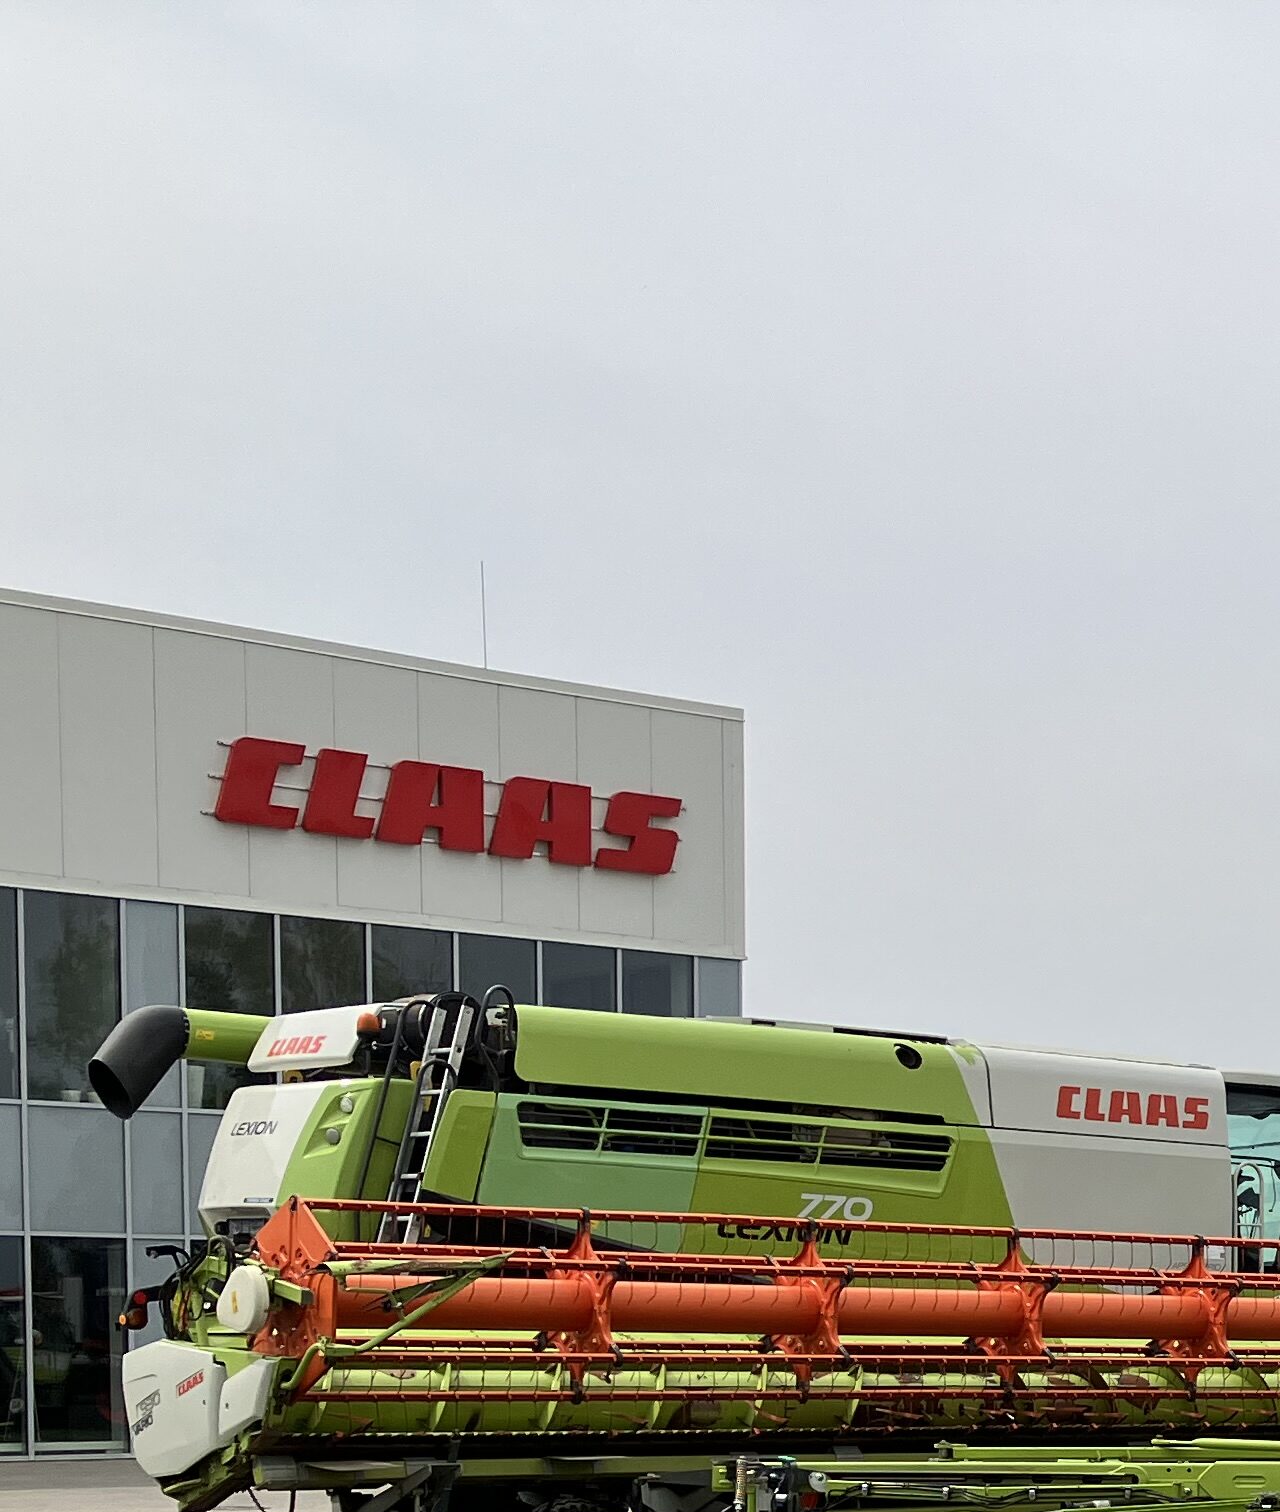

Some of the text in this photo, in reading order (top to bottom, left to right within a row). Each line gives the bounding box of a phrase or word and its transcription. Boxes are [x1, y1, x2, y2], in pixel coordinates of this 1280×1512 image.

[215, 736, 683, 875] CLAAS
[267, 1035, 328, 1057] CLAAS
[1056, 1085, 1210, 1130] CLAAS
[231, 1120, 279, 1136] LEXION
[797, 1193, 874, 1221] 770
